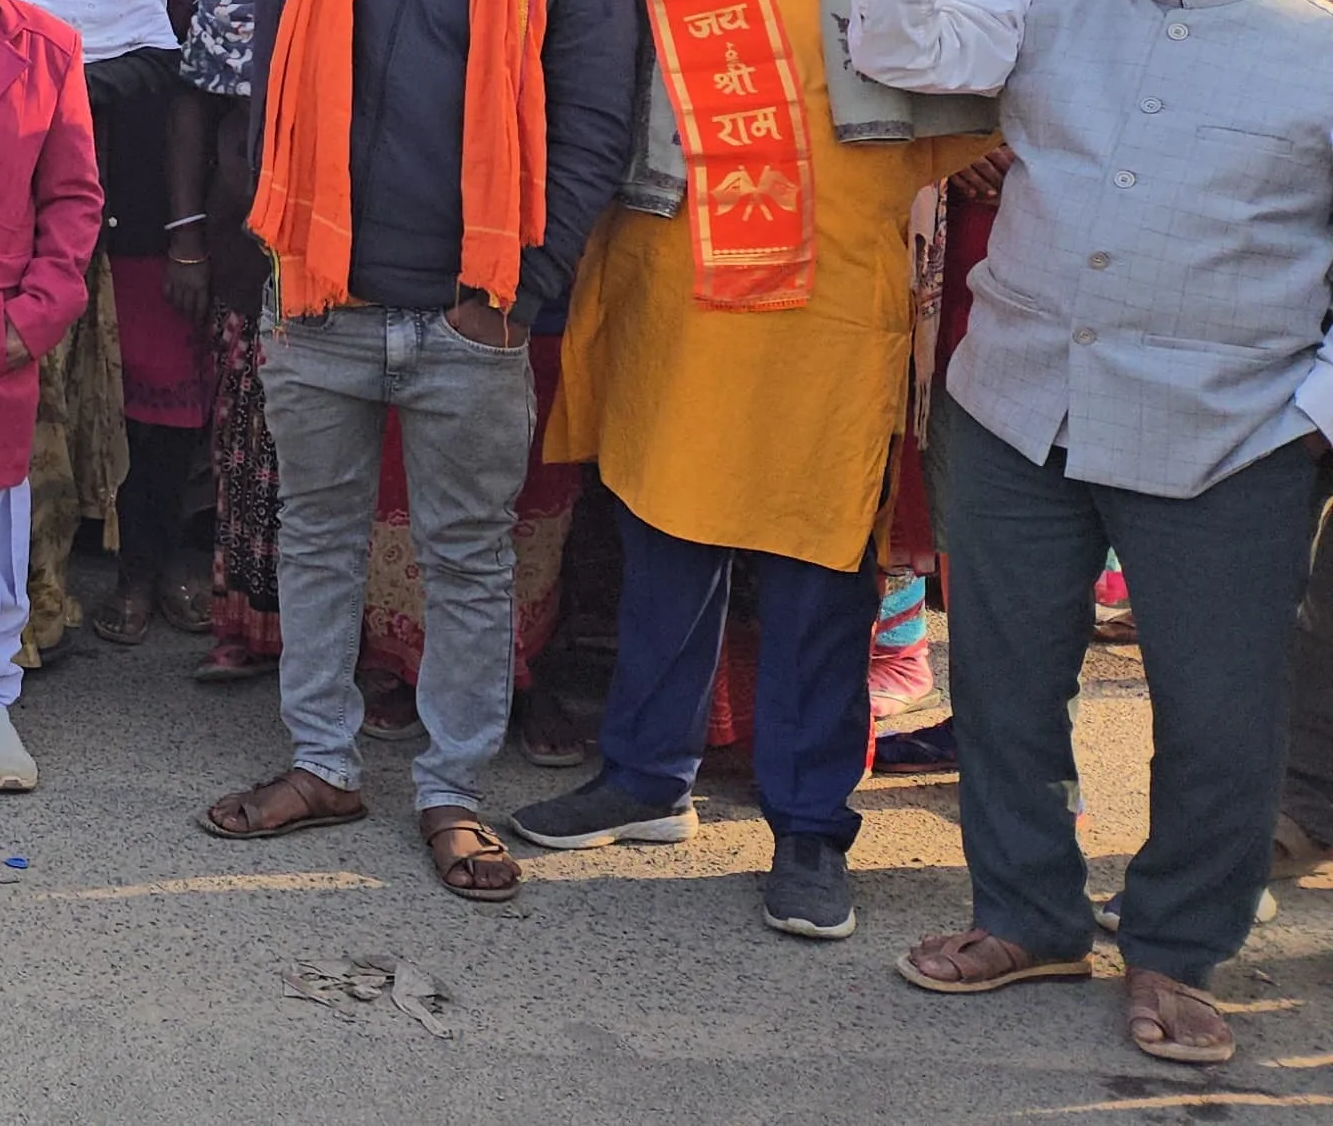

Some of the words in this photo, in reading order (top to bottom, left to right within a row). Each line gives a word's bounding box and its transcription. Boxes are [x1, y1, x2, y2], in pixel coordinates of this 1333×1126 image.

[683, 3, 750, 39] जय
[713, 63, 758, 97] श्री
[712, 105, 783, 147] राम
